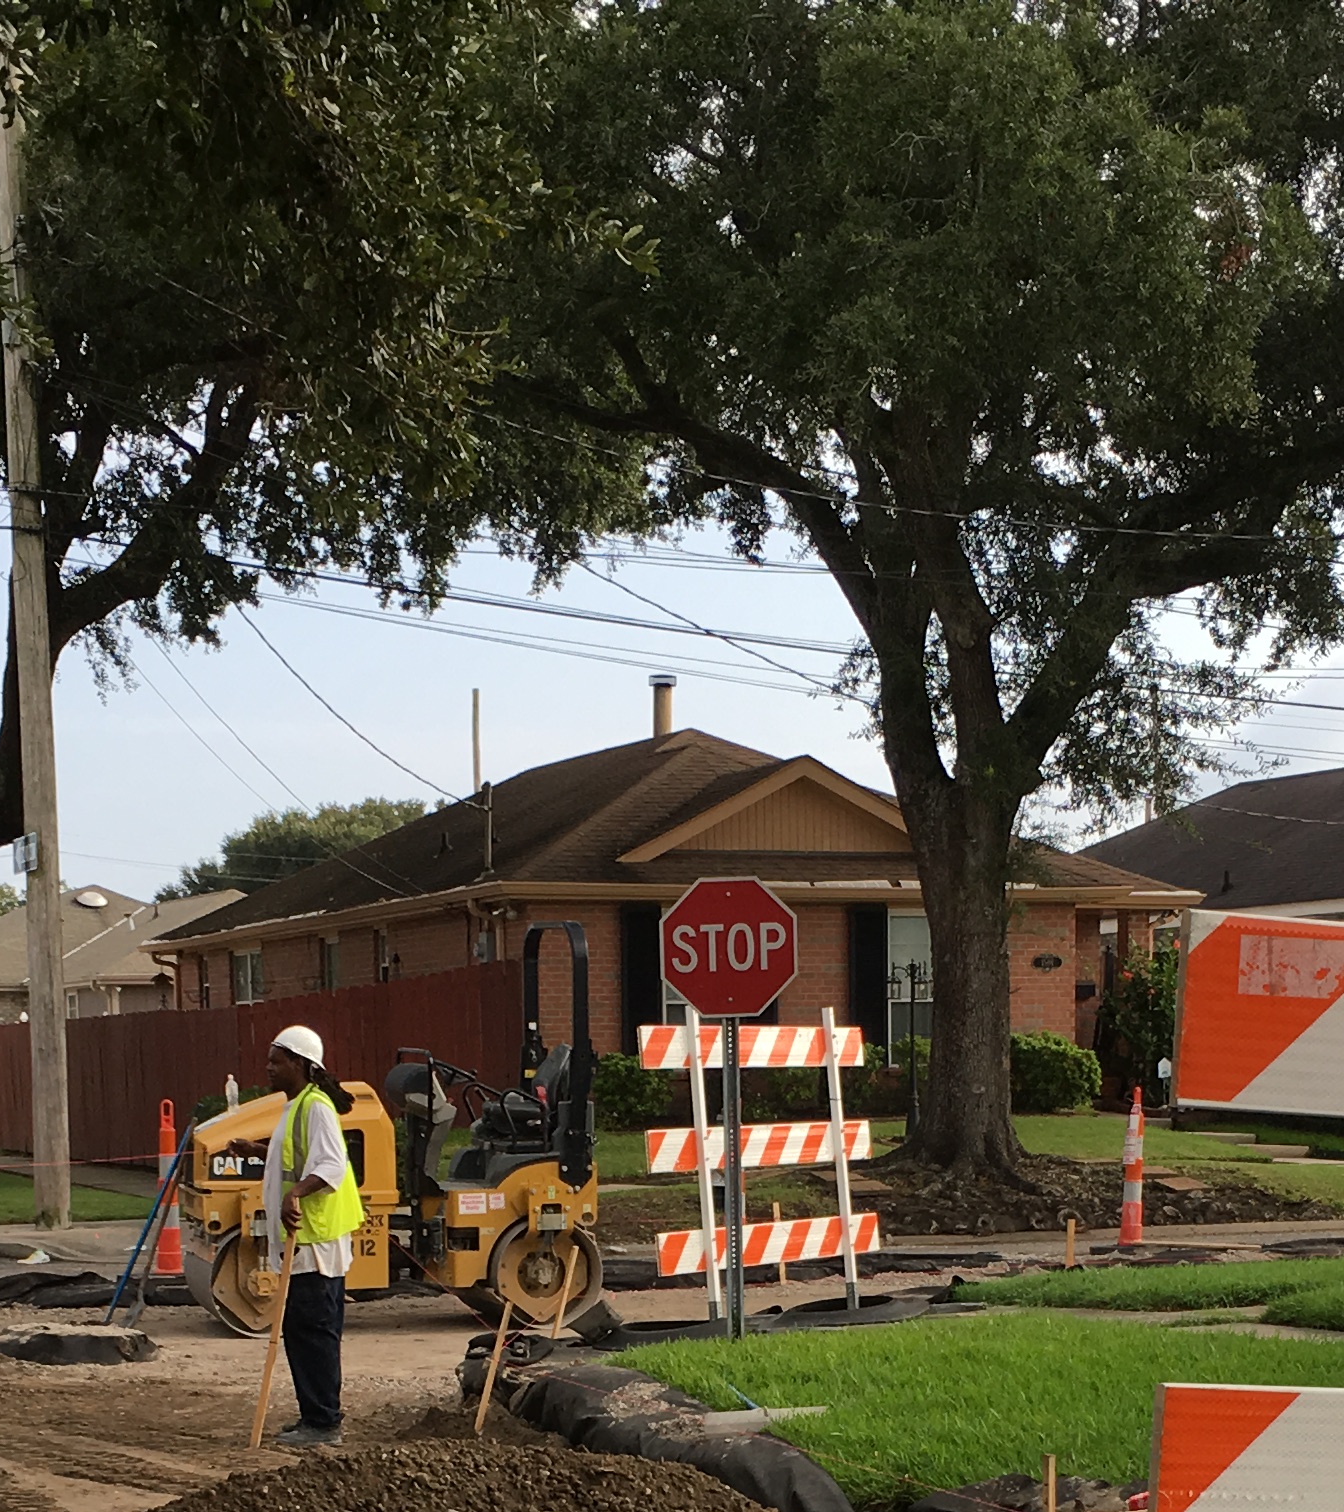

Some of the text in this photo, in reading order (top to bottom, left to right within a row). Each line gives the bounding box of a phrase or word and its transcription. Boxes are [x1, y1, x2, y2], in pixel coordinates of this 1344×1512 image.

[671, 922, 787, 974] STOP
[213, 1156, 245, 1176] CAT
[360, 1239, 376, 1256] 12
